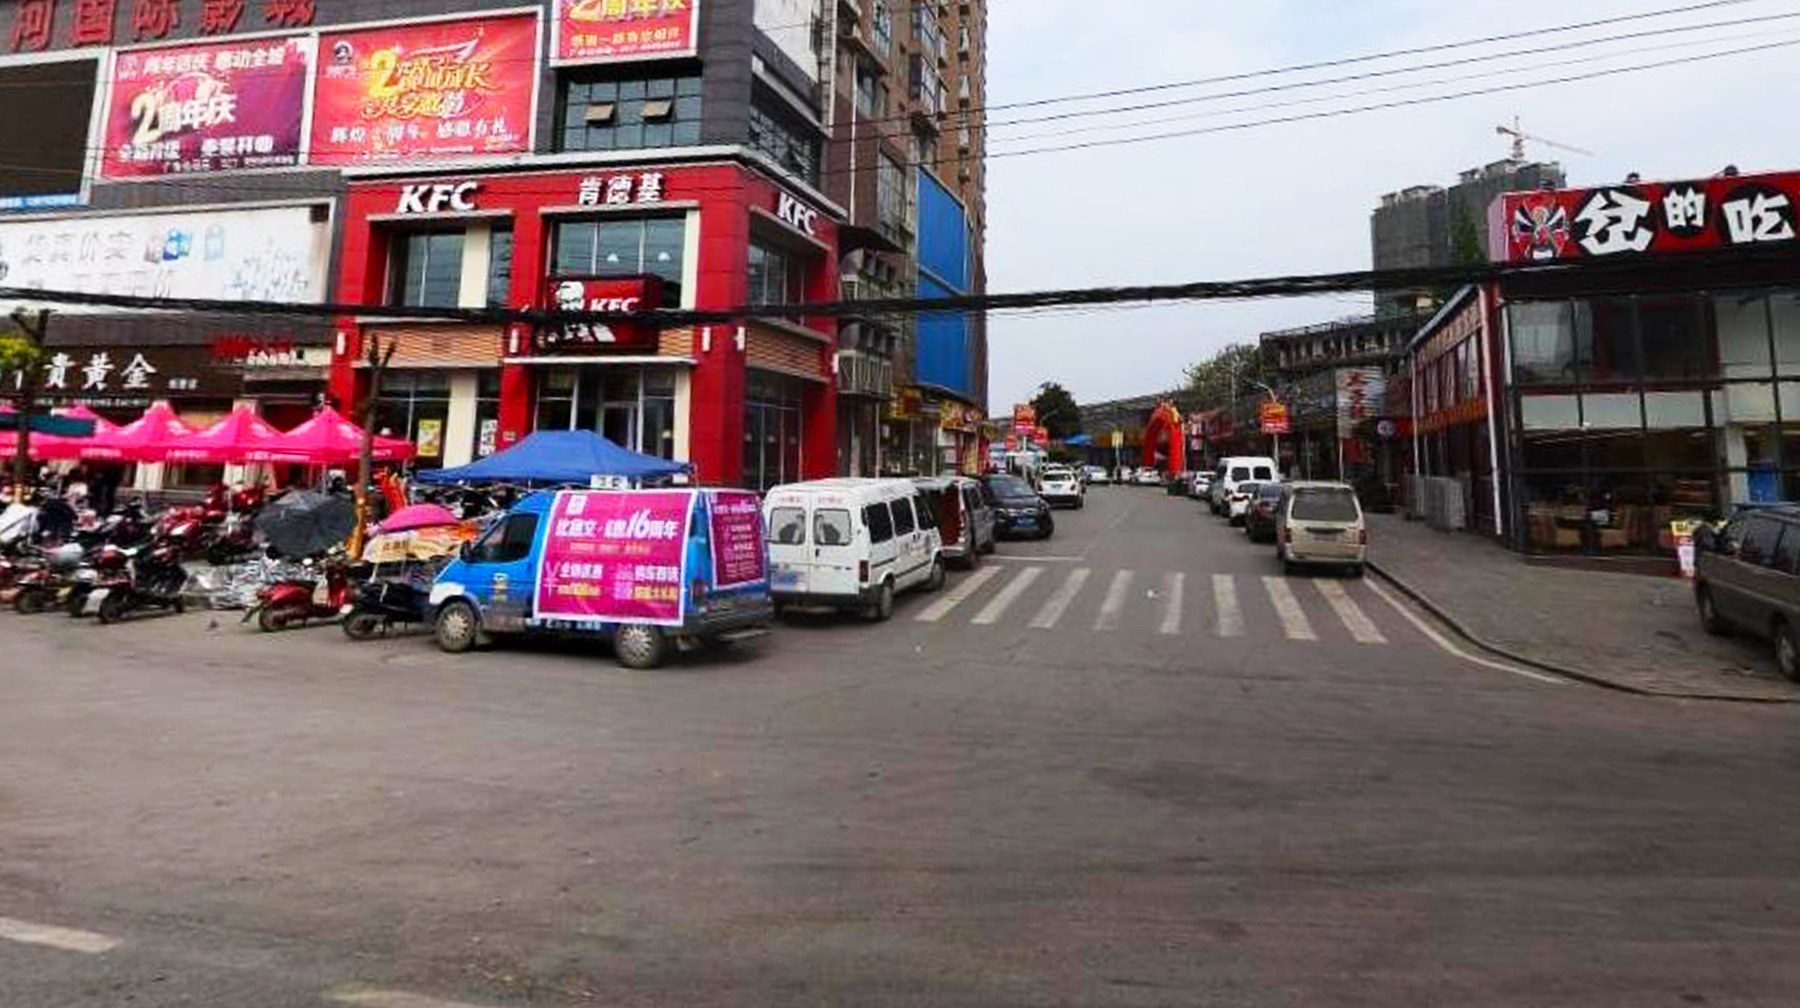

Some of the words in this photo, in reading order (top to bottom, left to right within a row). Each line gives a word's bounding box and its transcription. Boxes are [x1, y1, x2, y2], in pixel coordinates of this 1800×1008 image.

[396, 181, 480, 213] KFC
[577, 173, 665, 206] 肯德基
[776, 192, 819, 236] KFC
[589, 297, 640, 314] KFC
